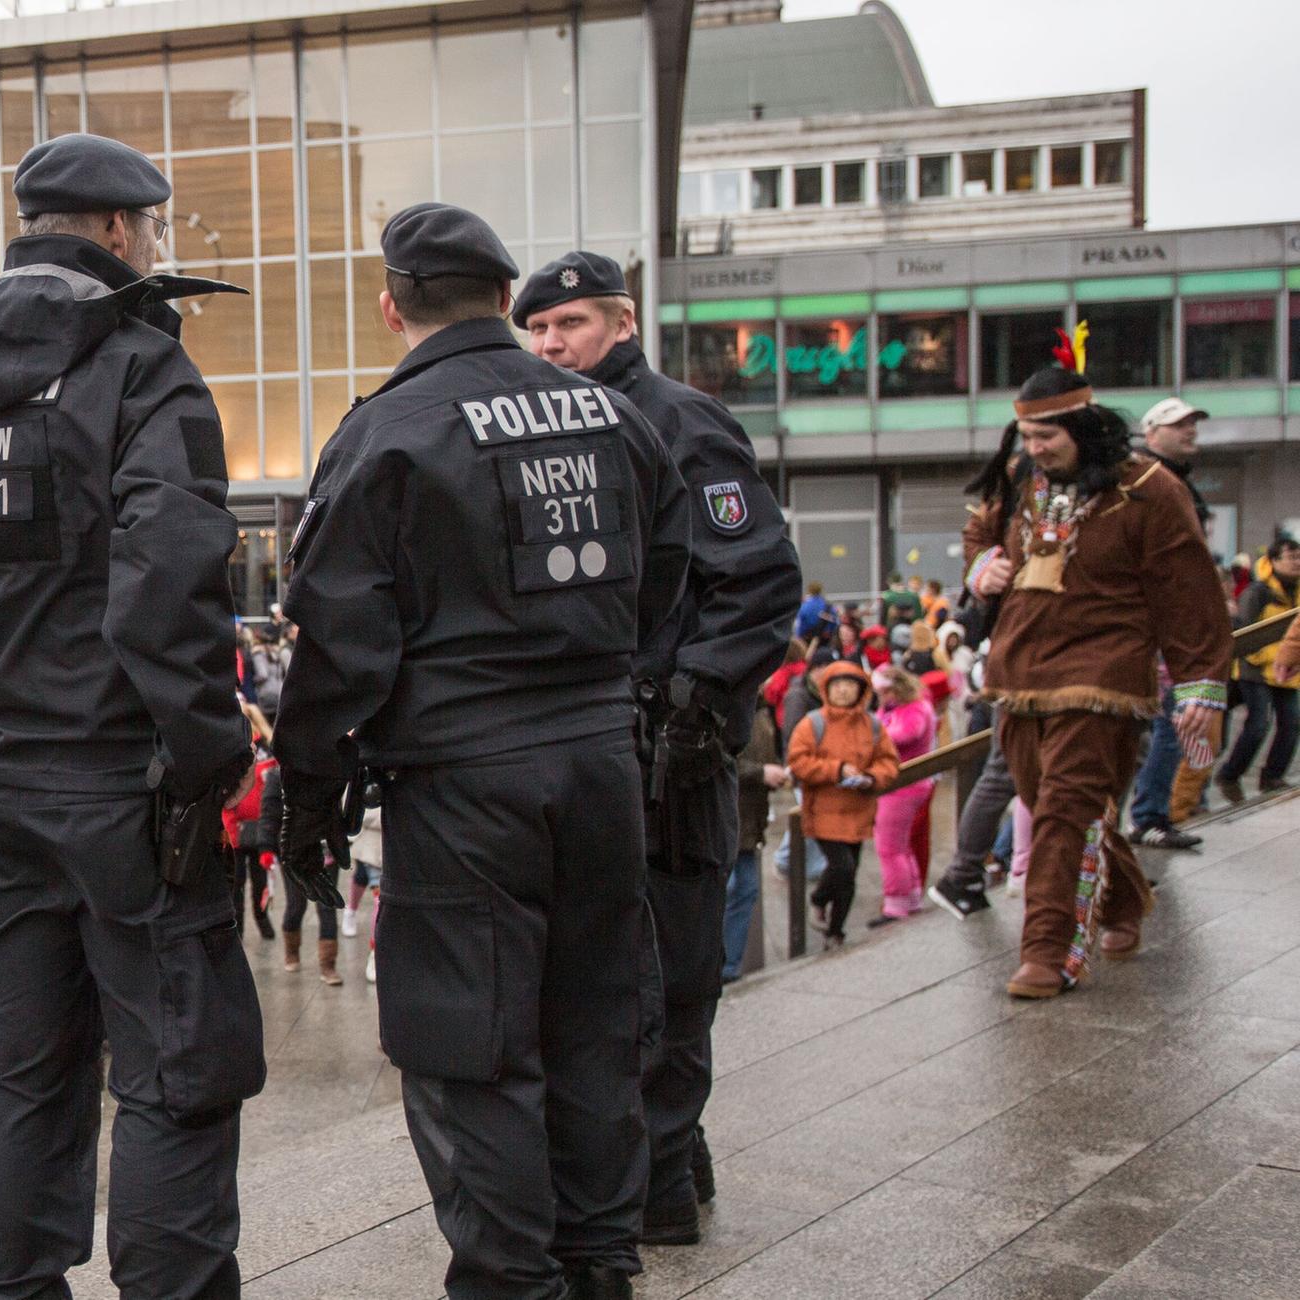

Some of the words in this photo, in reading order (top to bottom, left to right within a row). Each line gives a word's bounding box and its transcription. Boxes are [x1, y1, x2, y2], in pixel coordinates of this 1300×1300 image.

[1082, 245, 1167, 264] PRADA
[462, 387, 620, 441] POLIZEI
[520, 453, 598, 497] NRW
[706, 483, 740, 497] POLIZEI
[543, 494, 599, 535] 3T1
